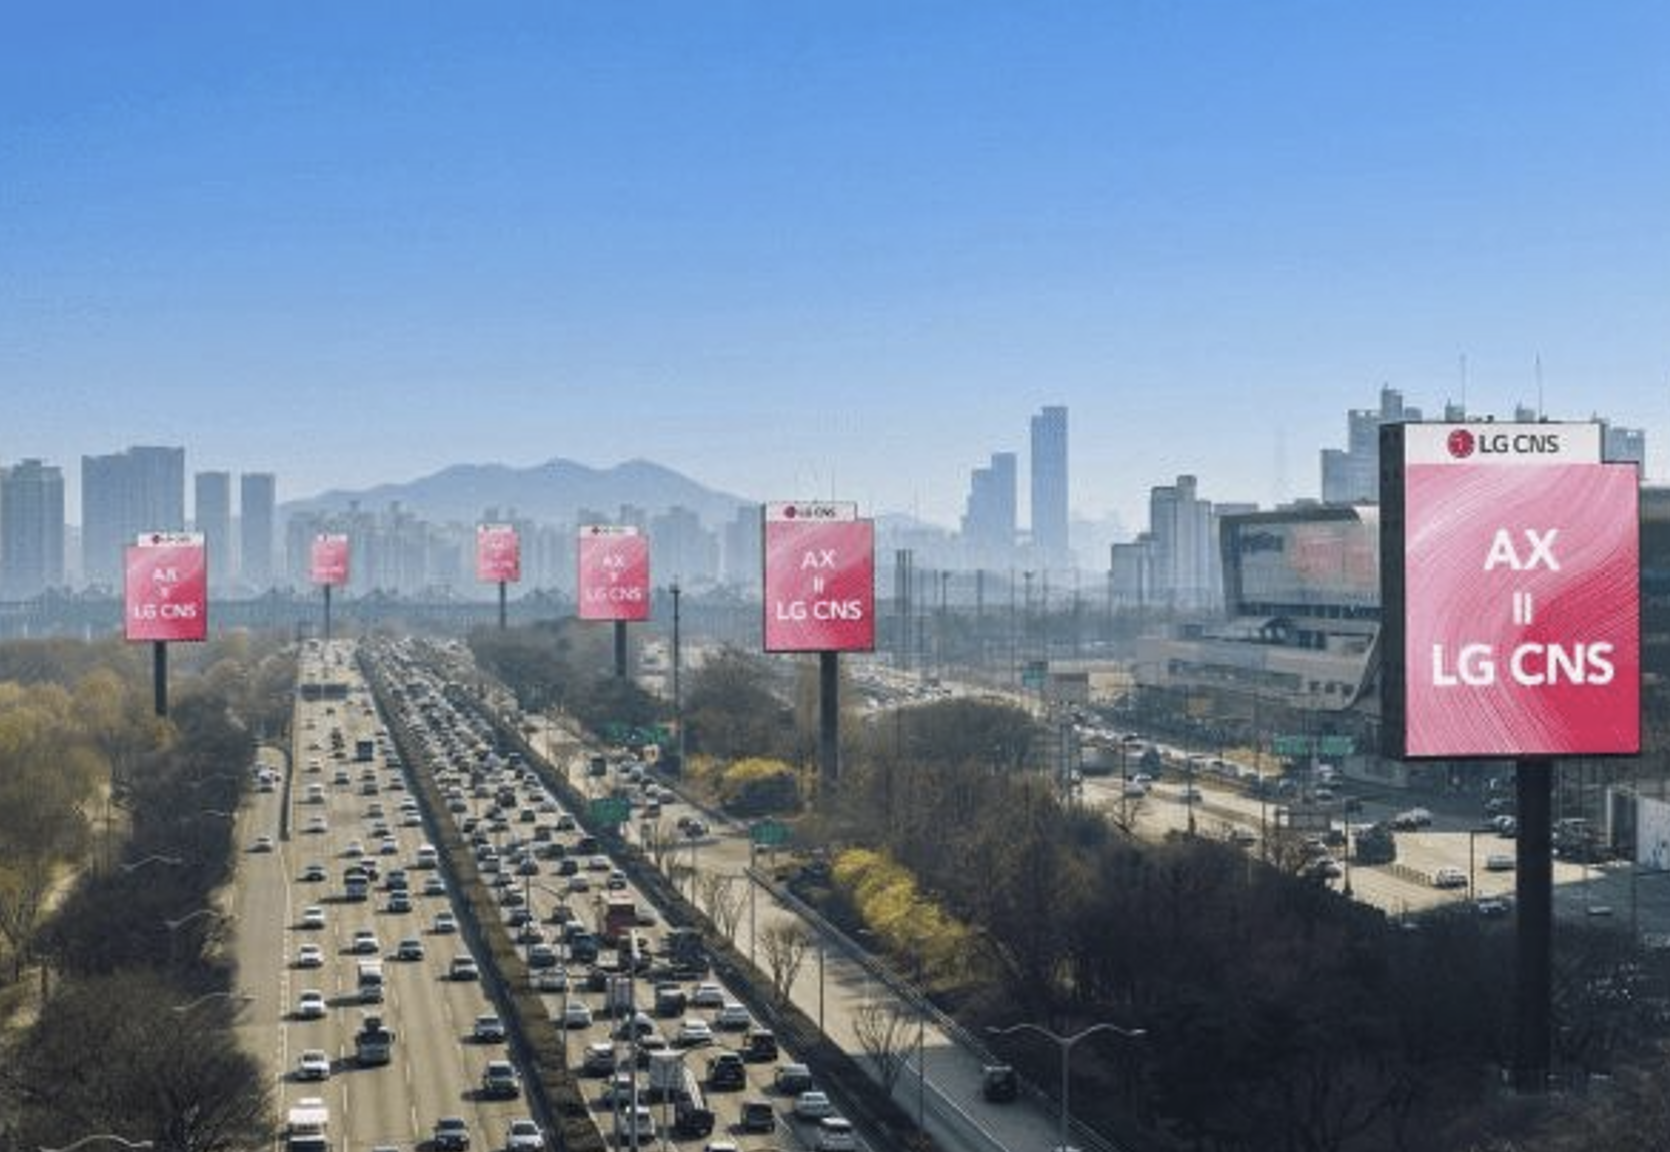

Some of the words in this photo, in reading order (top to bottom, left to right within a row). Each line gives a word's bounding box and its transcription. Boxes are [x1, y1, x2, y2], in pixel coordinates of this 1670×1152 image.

[1479, 435, 1508, 453] LG
[1513, 435, 1560, 453] CNS
[800, 548, 837, 571] AX
[1484, 529, 1560, 570] AX
[777, 601, 807, 620] LG
[814, 600, 862, 620] CNS
[1432, 644, 1495, 687] LG
[1510, 643, 1615, 687] CNS
